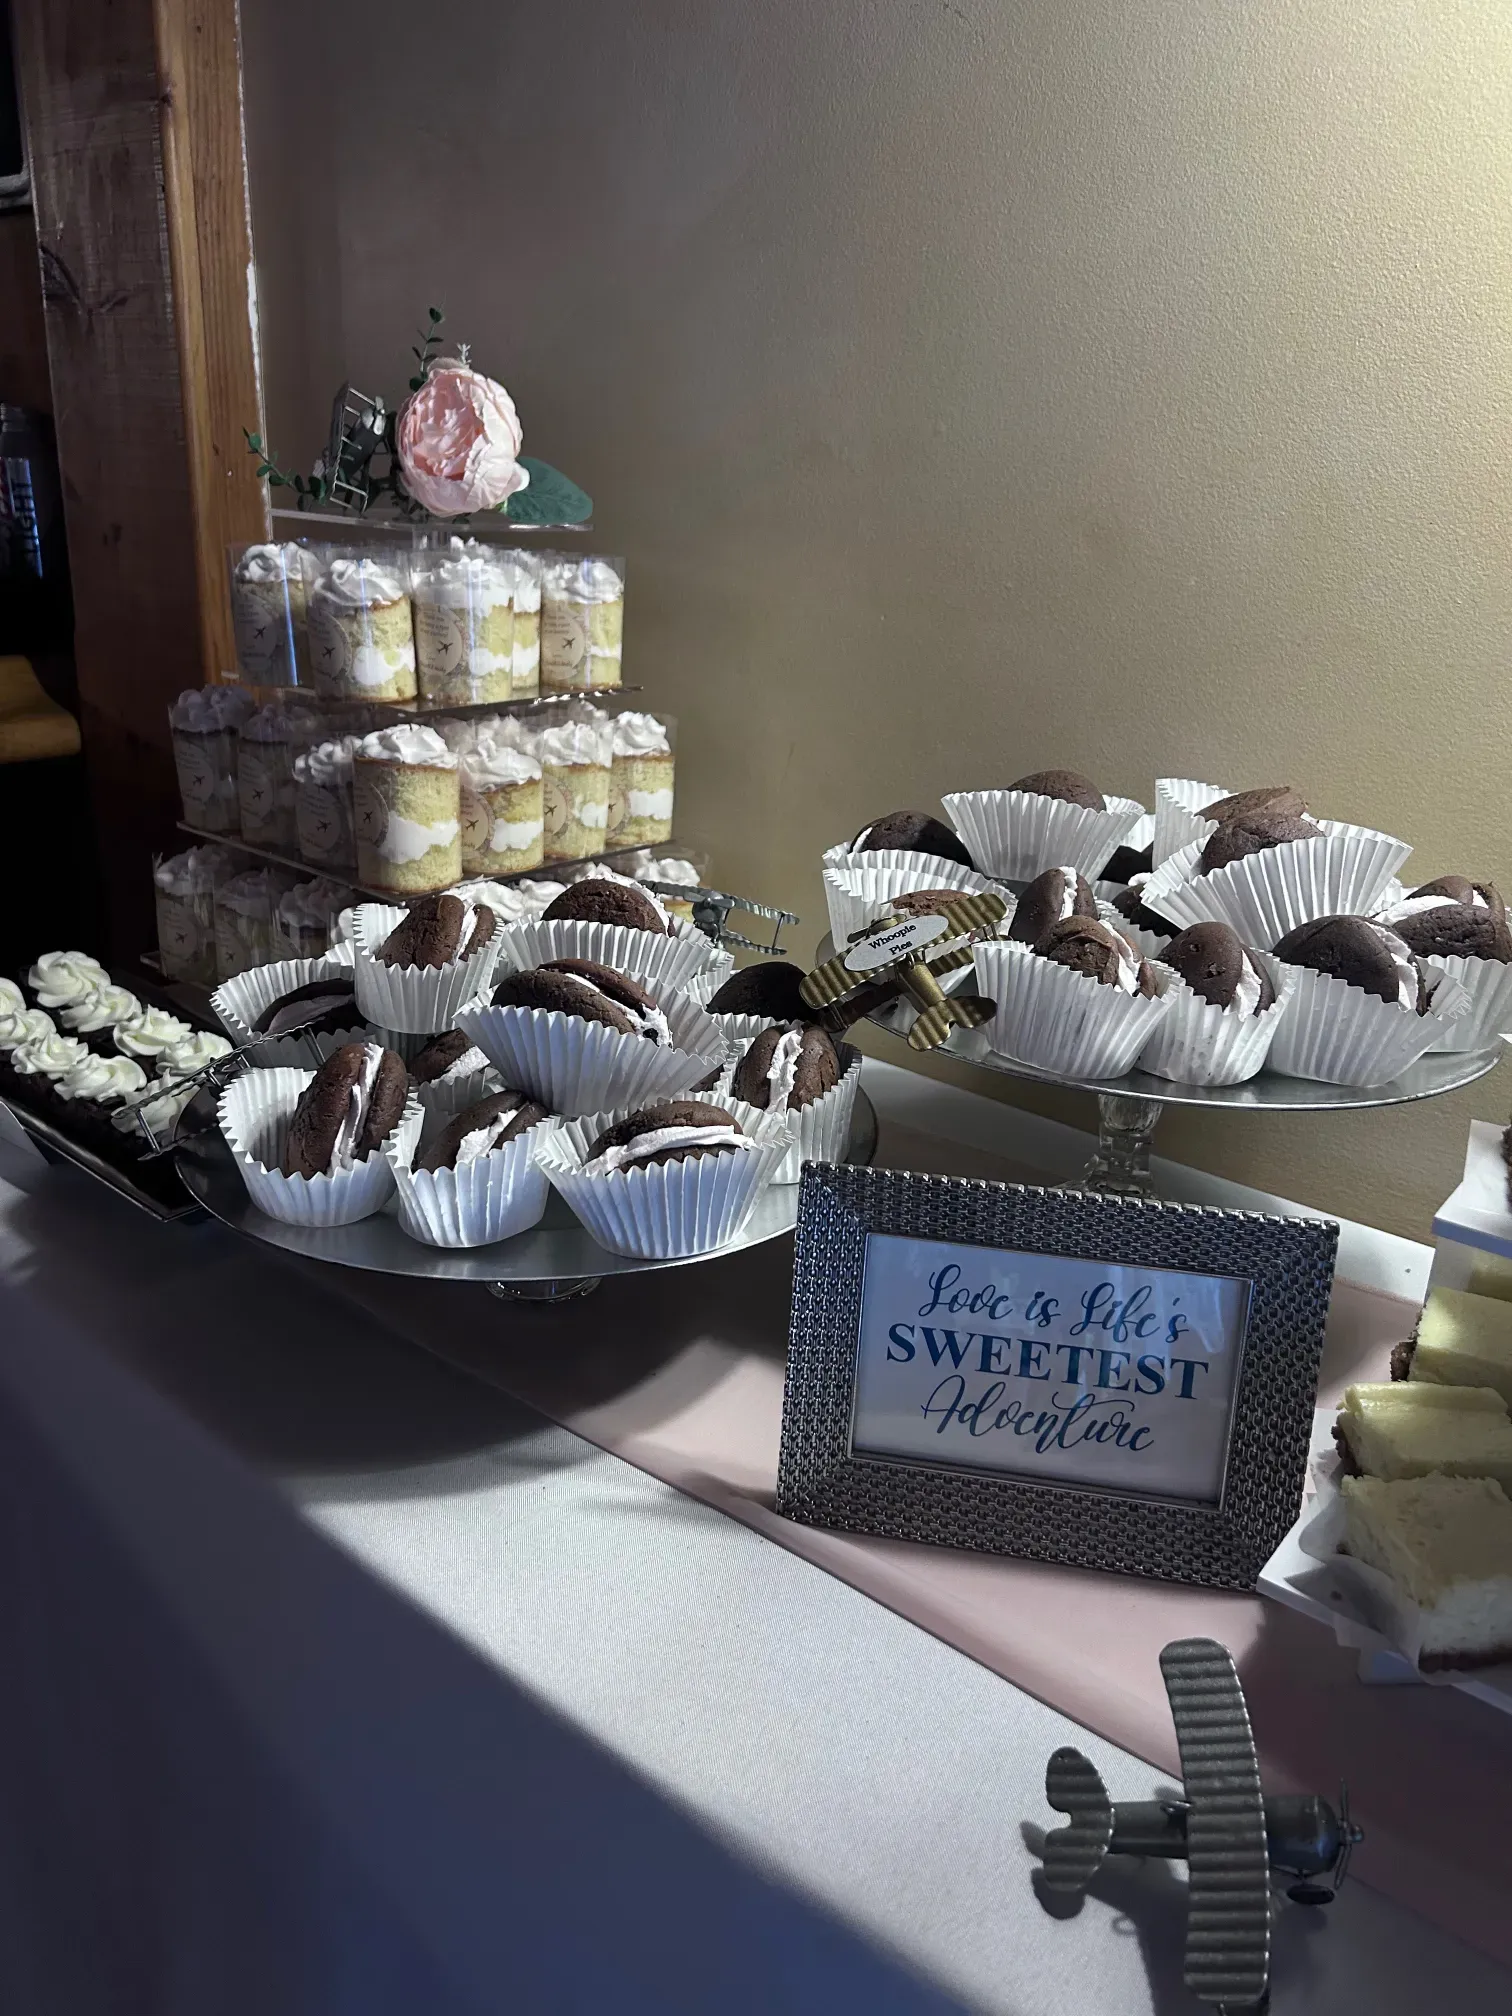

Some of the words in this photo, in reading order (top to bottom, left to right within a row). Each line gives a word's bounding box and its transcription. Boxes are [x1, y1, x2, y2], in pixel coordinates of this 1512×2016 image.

[868, 924, 917, 949] Whoopie
[888, 941, 912, 955] Pies
[918, 1264, 1014, 1319] Love
[1024, 1290, 1060, 1328] is
[1070, 1281, 1188, 1344] Life's
[886, 1323, 1209, 1399] SWEETEST
[921, 1375, 1155, 1454] Adventure
